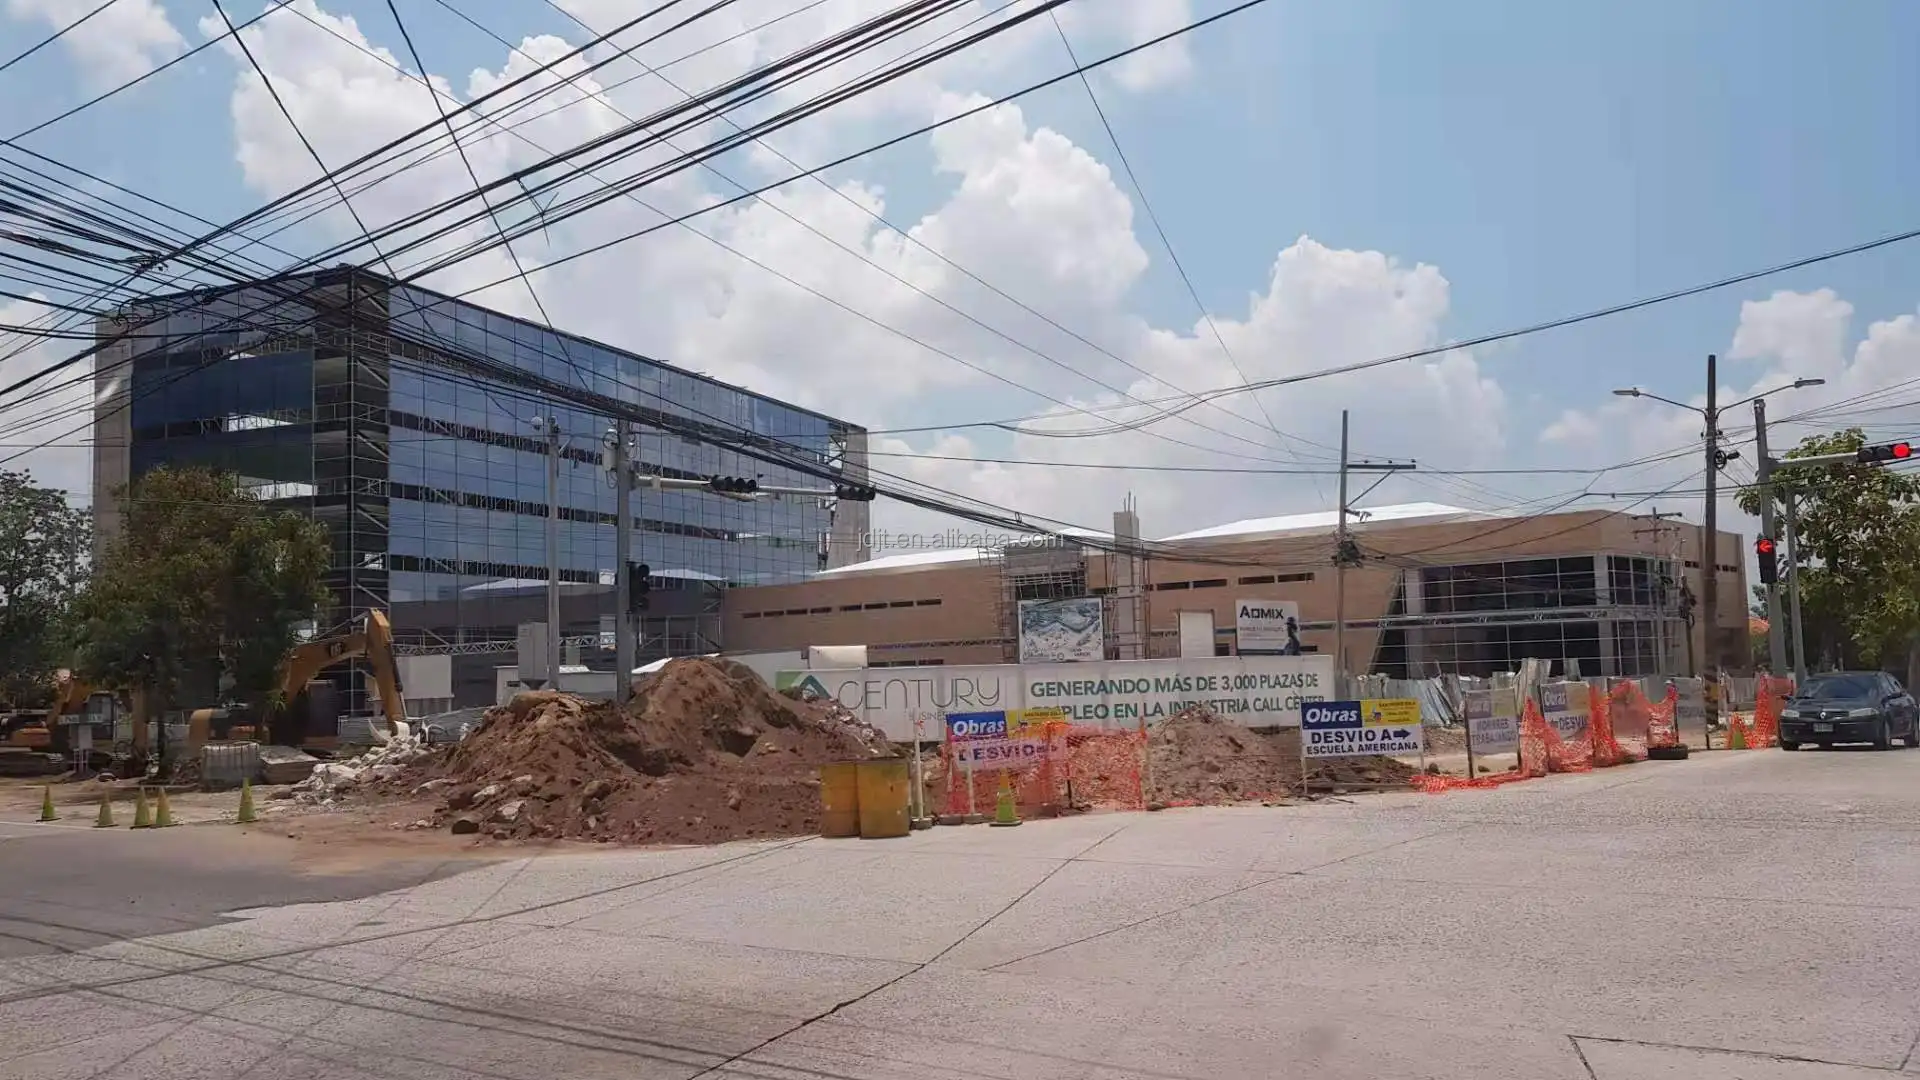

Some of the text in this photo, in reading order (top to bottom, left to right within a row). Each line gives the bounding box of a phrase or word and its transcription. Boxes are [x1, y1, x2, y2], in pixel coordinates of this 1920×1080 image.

[837, 677, 1000, 710] CENTURY
[1031, 673, 1318, 697] GENERANDO MÁS DE 3,000 PLAZAS DE
[1032, 704, 1109, 719] PLEO
[1114, 703, 1138, 718] EN
[1143, 702, 1164, 717] LA
[1168, 699, 1249, 716] INSTRIA
[1253, 697, 1283, 712] CALL
[1306, 708, 1358, 723] Obras
[953, 719, 1005, 736] Obras
[1311, 729, 1392, 744] DESVIO A
[1307, 741, 1418, 754] ESCUELA AMERICANA
